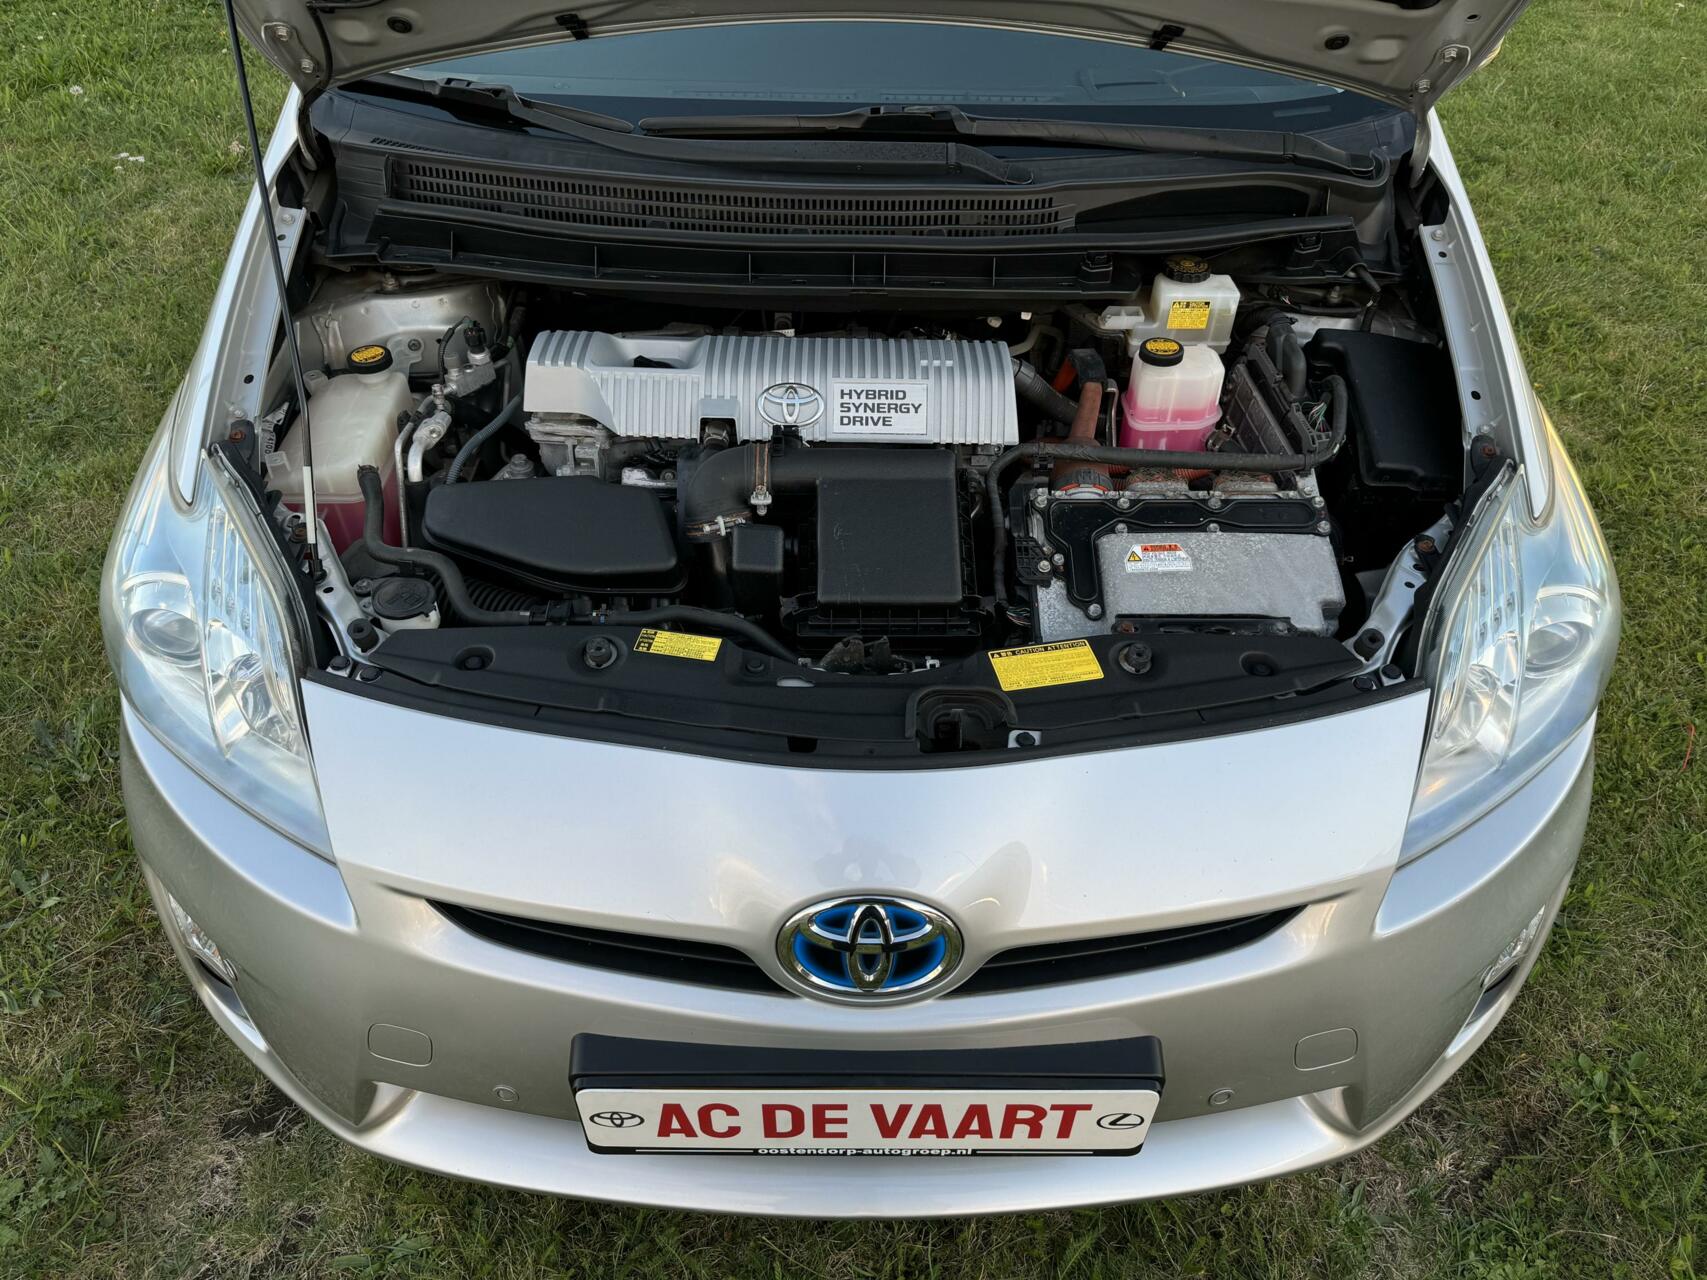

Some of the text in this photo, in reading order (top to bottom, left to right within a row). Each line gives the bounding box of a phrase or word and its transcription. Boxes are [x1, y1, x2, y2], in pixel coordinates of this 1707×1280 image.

[840, 389, 907, 400] HYBRID
[840, 402, 922, 414] SYNERGY
[840, 415, 893, 427] DRIVE
[1015, 647, 1045, 656] CAUTION
[1047, 641, 1086, 652] ATTENTION
[657, 1103, 1093, 1139] AC DE VAART
[758, 1147, 972, 1156] oostendorp-autogroep.nl
